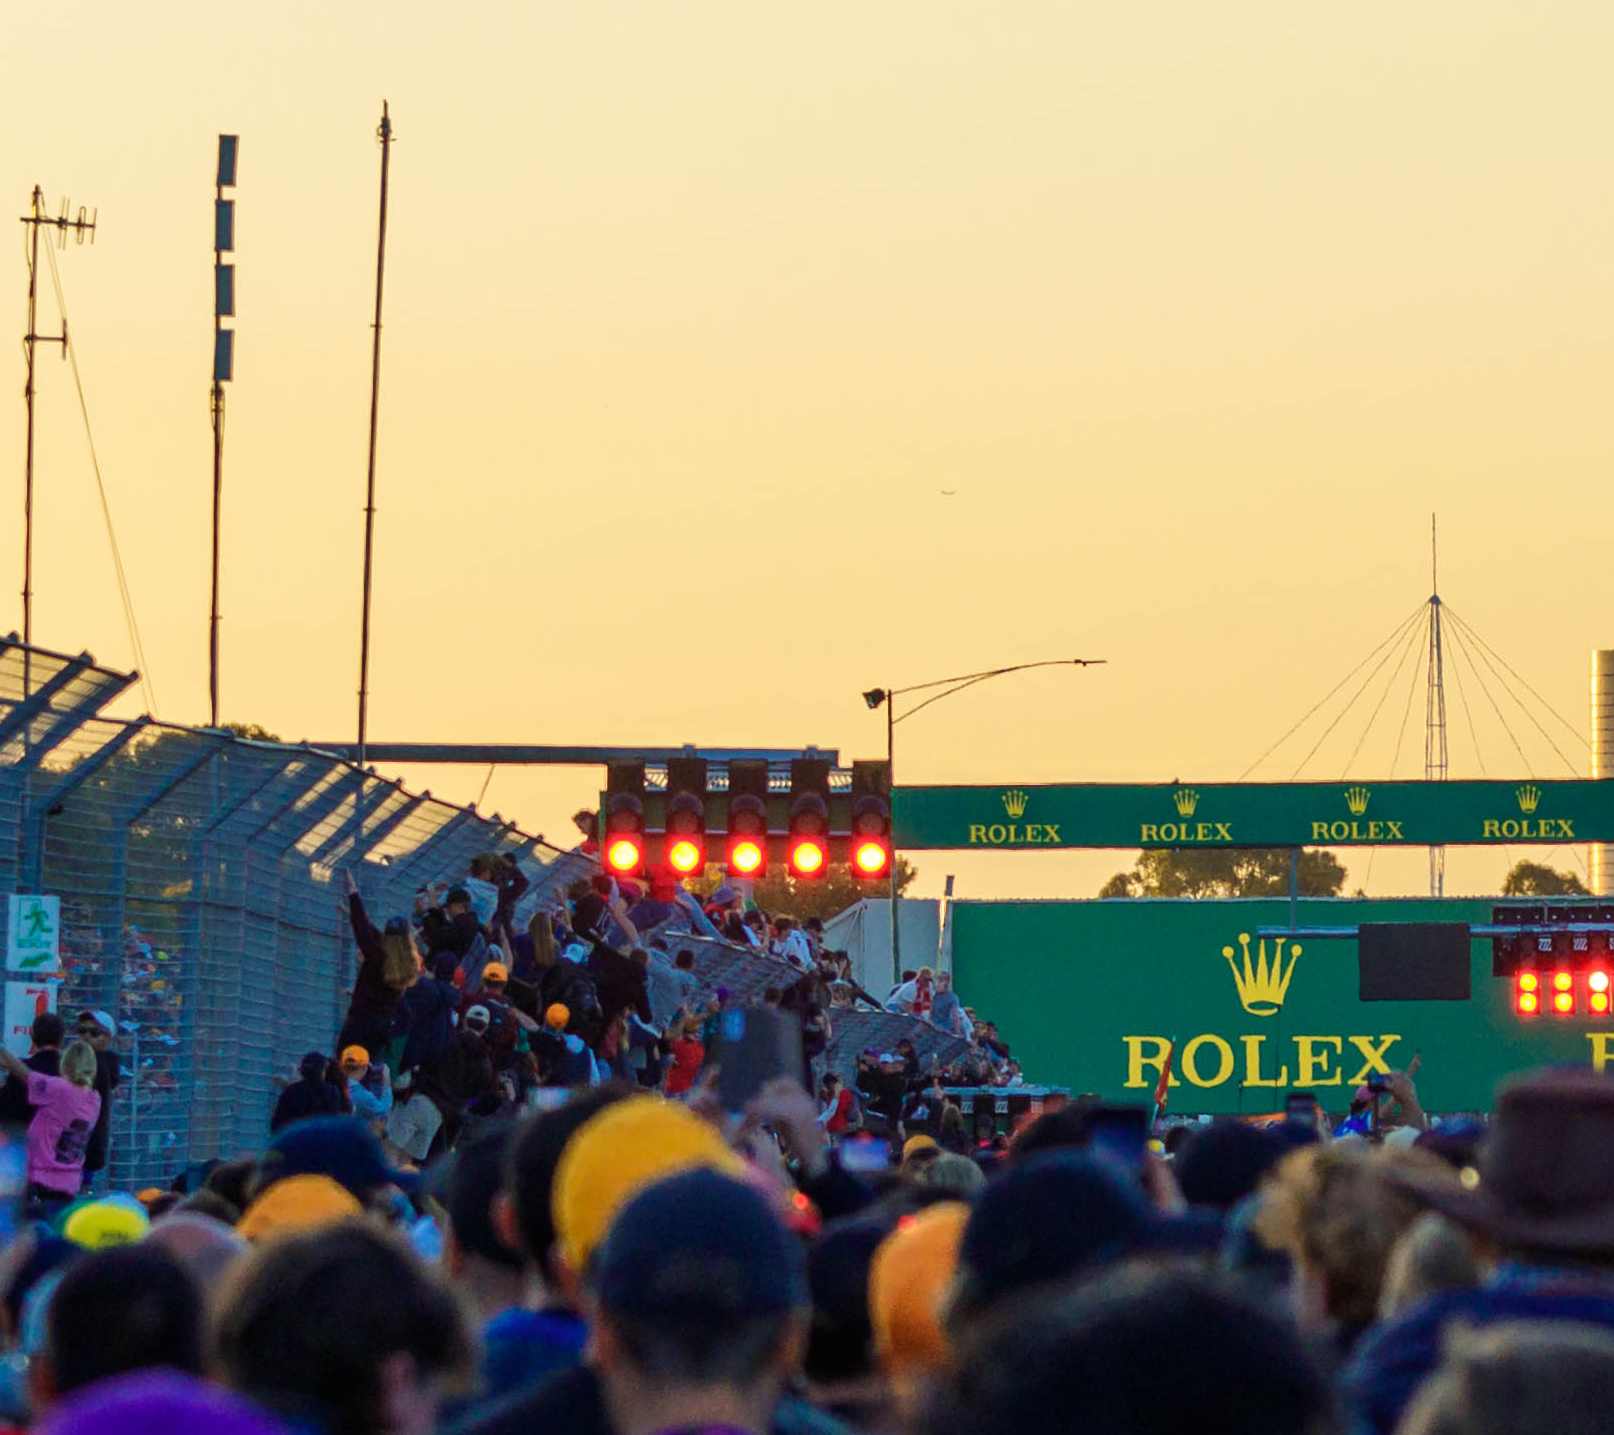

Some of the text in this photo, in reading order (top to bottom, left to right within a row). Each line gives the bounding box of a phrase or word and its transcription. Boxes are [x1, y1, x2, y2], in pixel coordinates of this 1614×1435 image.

[968, 824, 1062, 844] ROLEX
[1140, 822, 1234, 842] ROLEX
[1311, 820, 1404, 840] ROLEX
[1482, 818, 1576, 838] ROLEX
[1121, 1033, 1403, 1088] ROLEX
